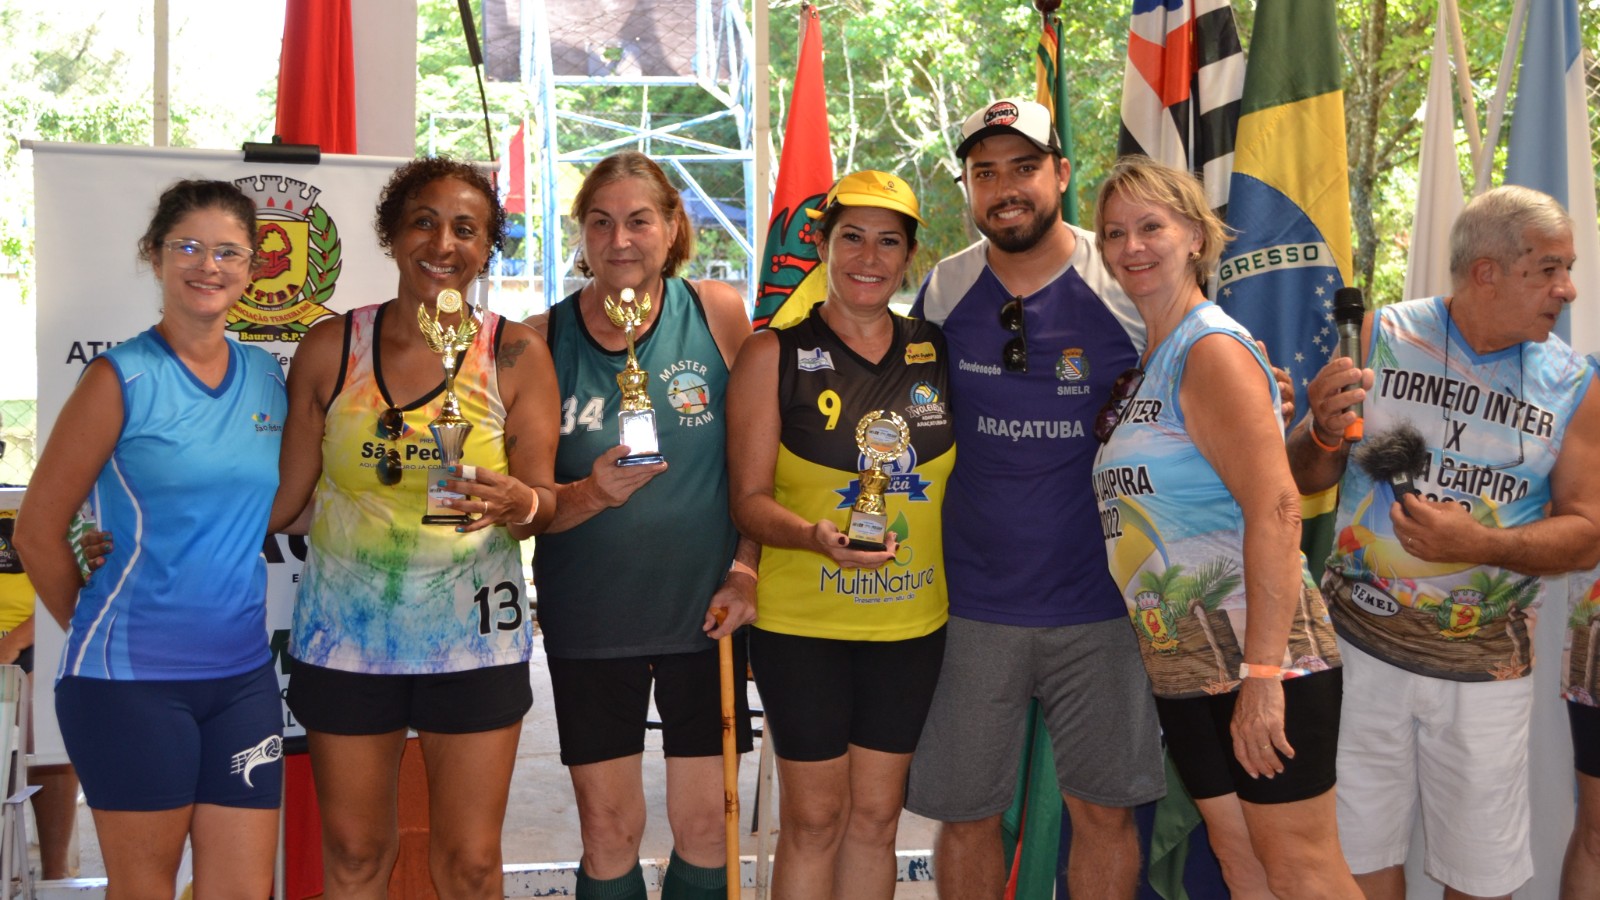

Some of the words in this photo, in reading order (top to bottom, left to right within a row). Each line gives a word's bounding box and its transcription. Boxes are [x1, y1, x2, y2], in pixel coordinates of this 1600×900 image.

[240, 332, 274, 341] Bauru
[65, 341, 125, 365] AT
[959, 358, 1002, 376] Coordenação
[659, 360, 708, 383] MASTER
[1057, 385, 1091, 396] SMELR
[1380, 368, 1481, 416] TORNEIO
[1482, 390, 1555, 438] INTER
[560, 396, 605, 436] 34
[678, 411, 715, 427] TEAM
[817, 389, 842, 431] 9
[977, 415, 1085, 442] ARAÇATUBA
[1446, 420, 1467, 452] X
[1100, 506, 1123, 540] 022
[820, 565, 934, 595] MultiNature
[473, 581, 522, 635] 13
[1353, 584, 1395, 613] SEMEL
